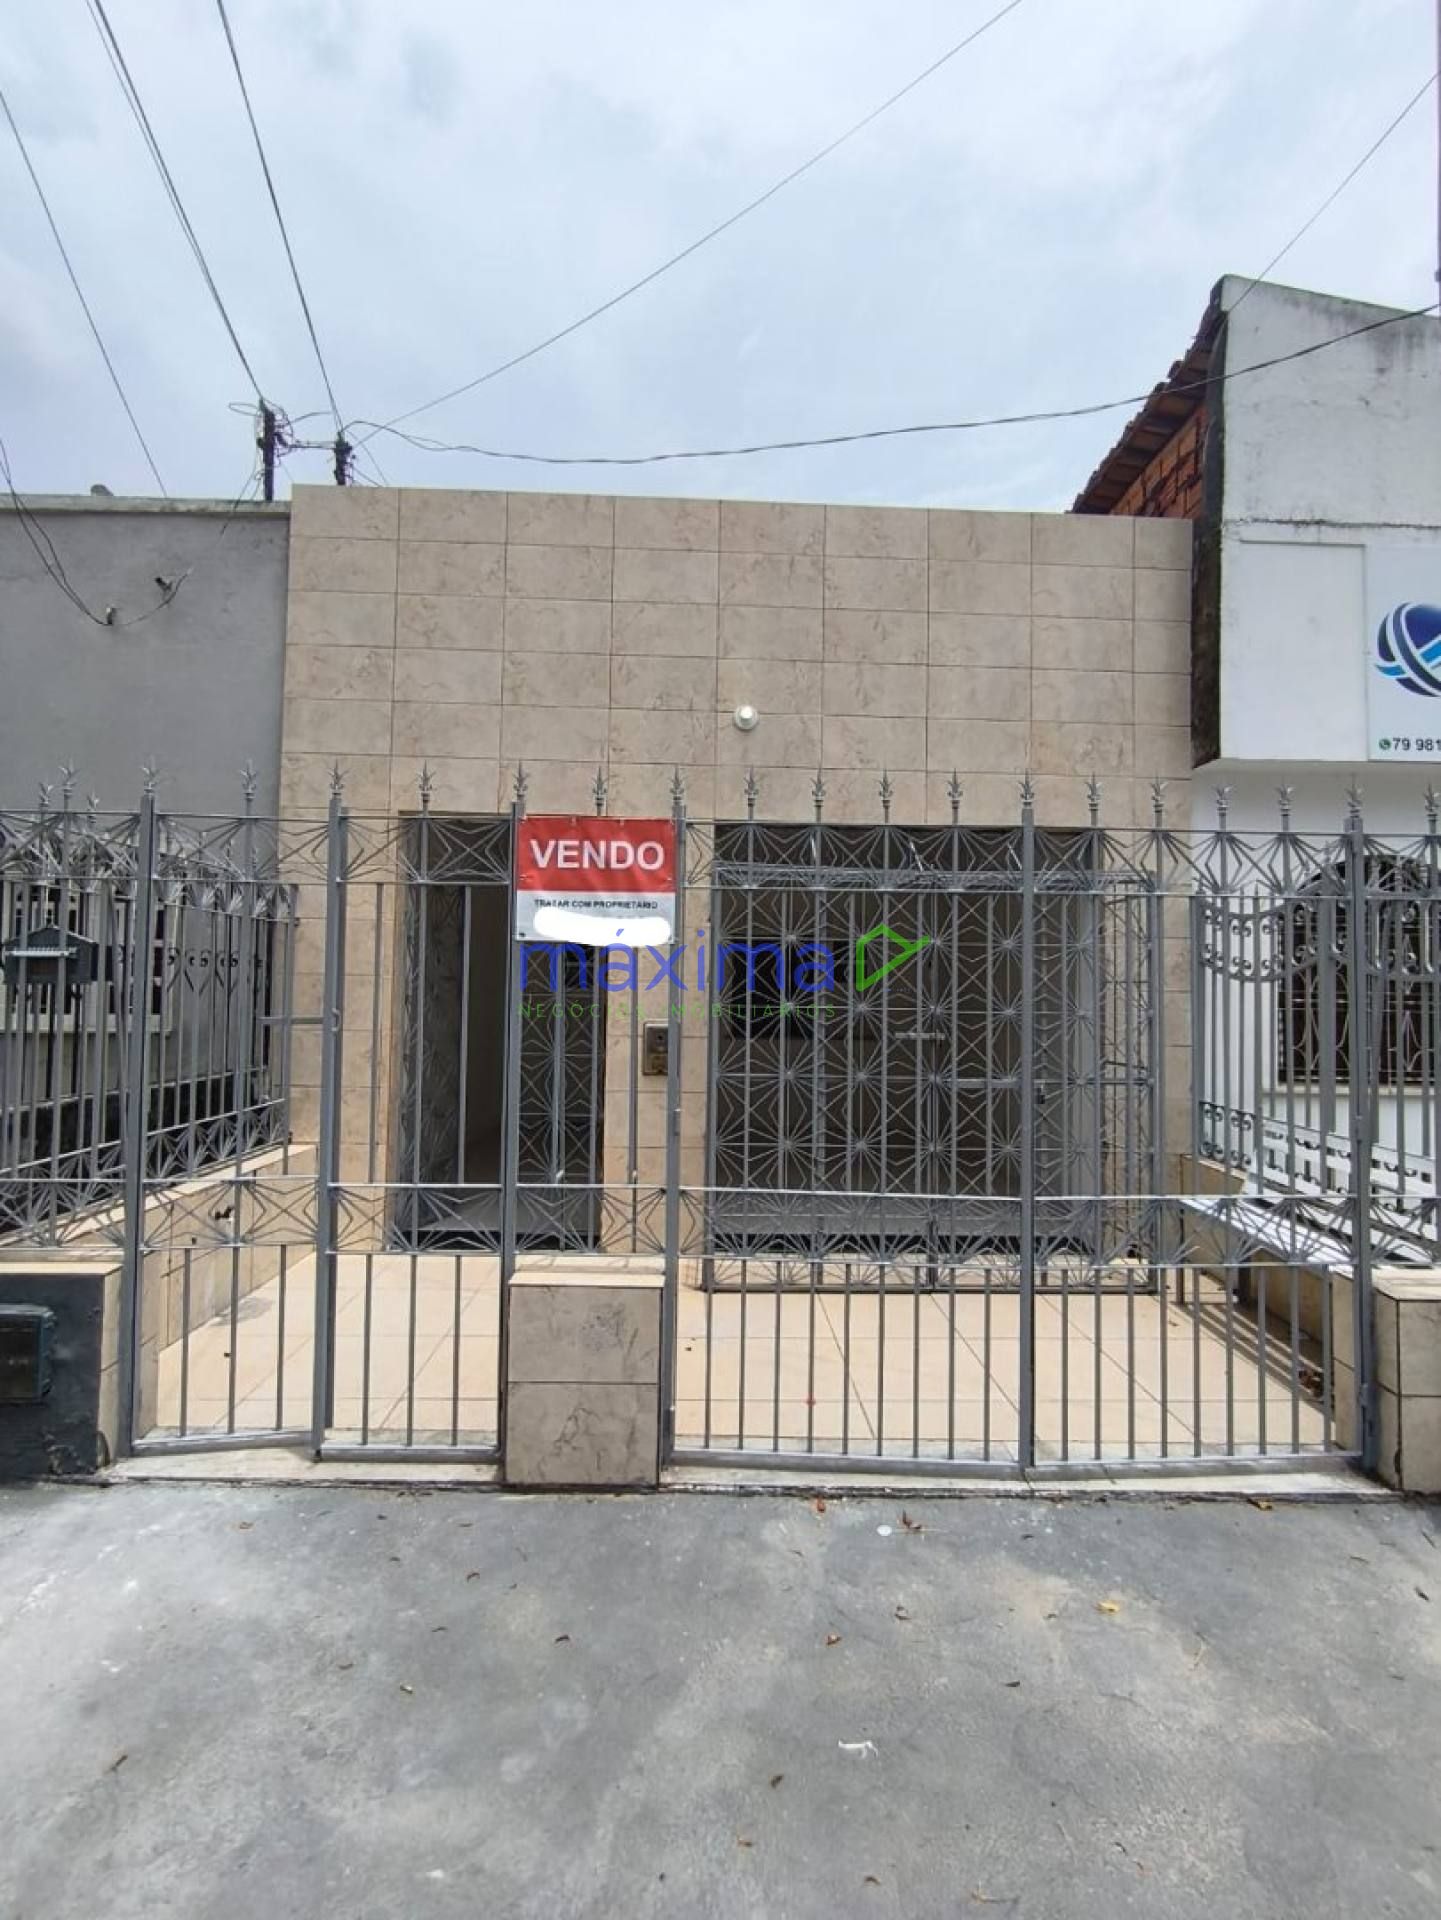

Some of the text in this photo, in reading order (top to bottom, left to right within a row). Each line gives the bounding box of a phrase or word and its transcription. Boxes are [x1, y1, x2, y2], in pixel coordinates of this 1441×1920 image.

[1392, 738, 1410, 751] 79
[529, 838, 665, 870] VENDO
[534, 899, 569, 908] TRATAR
